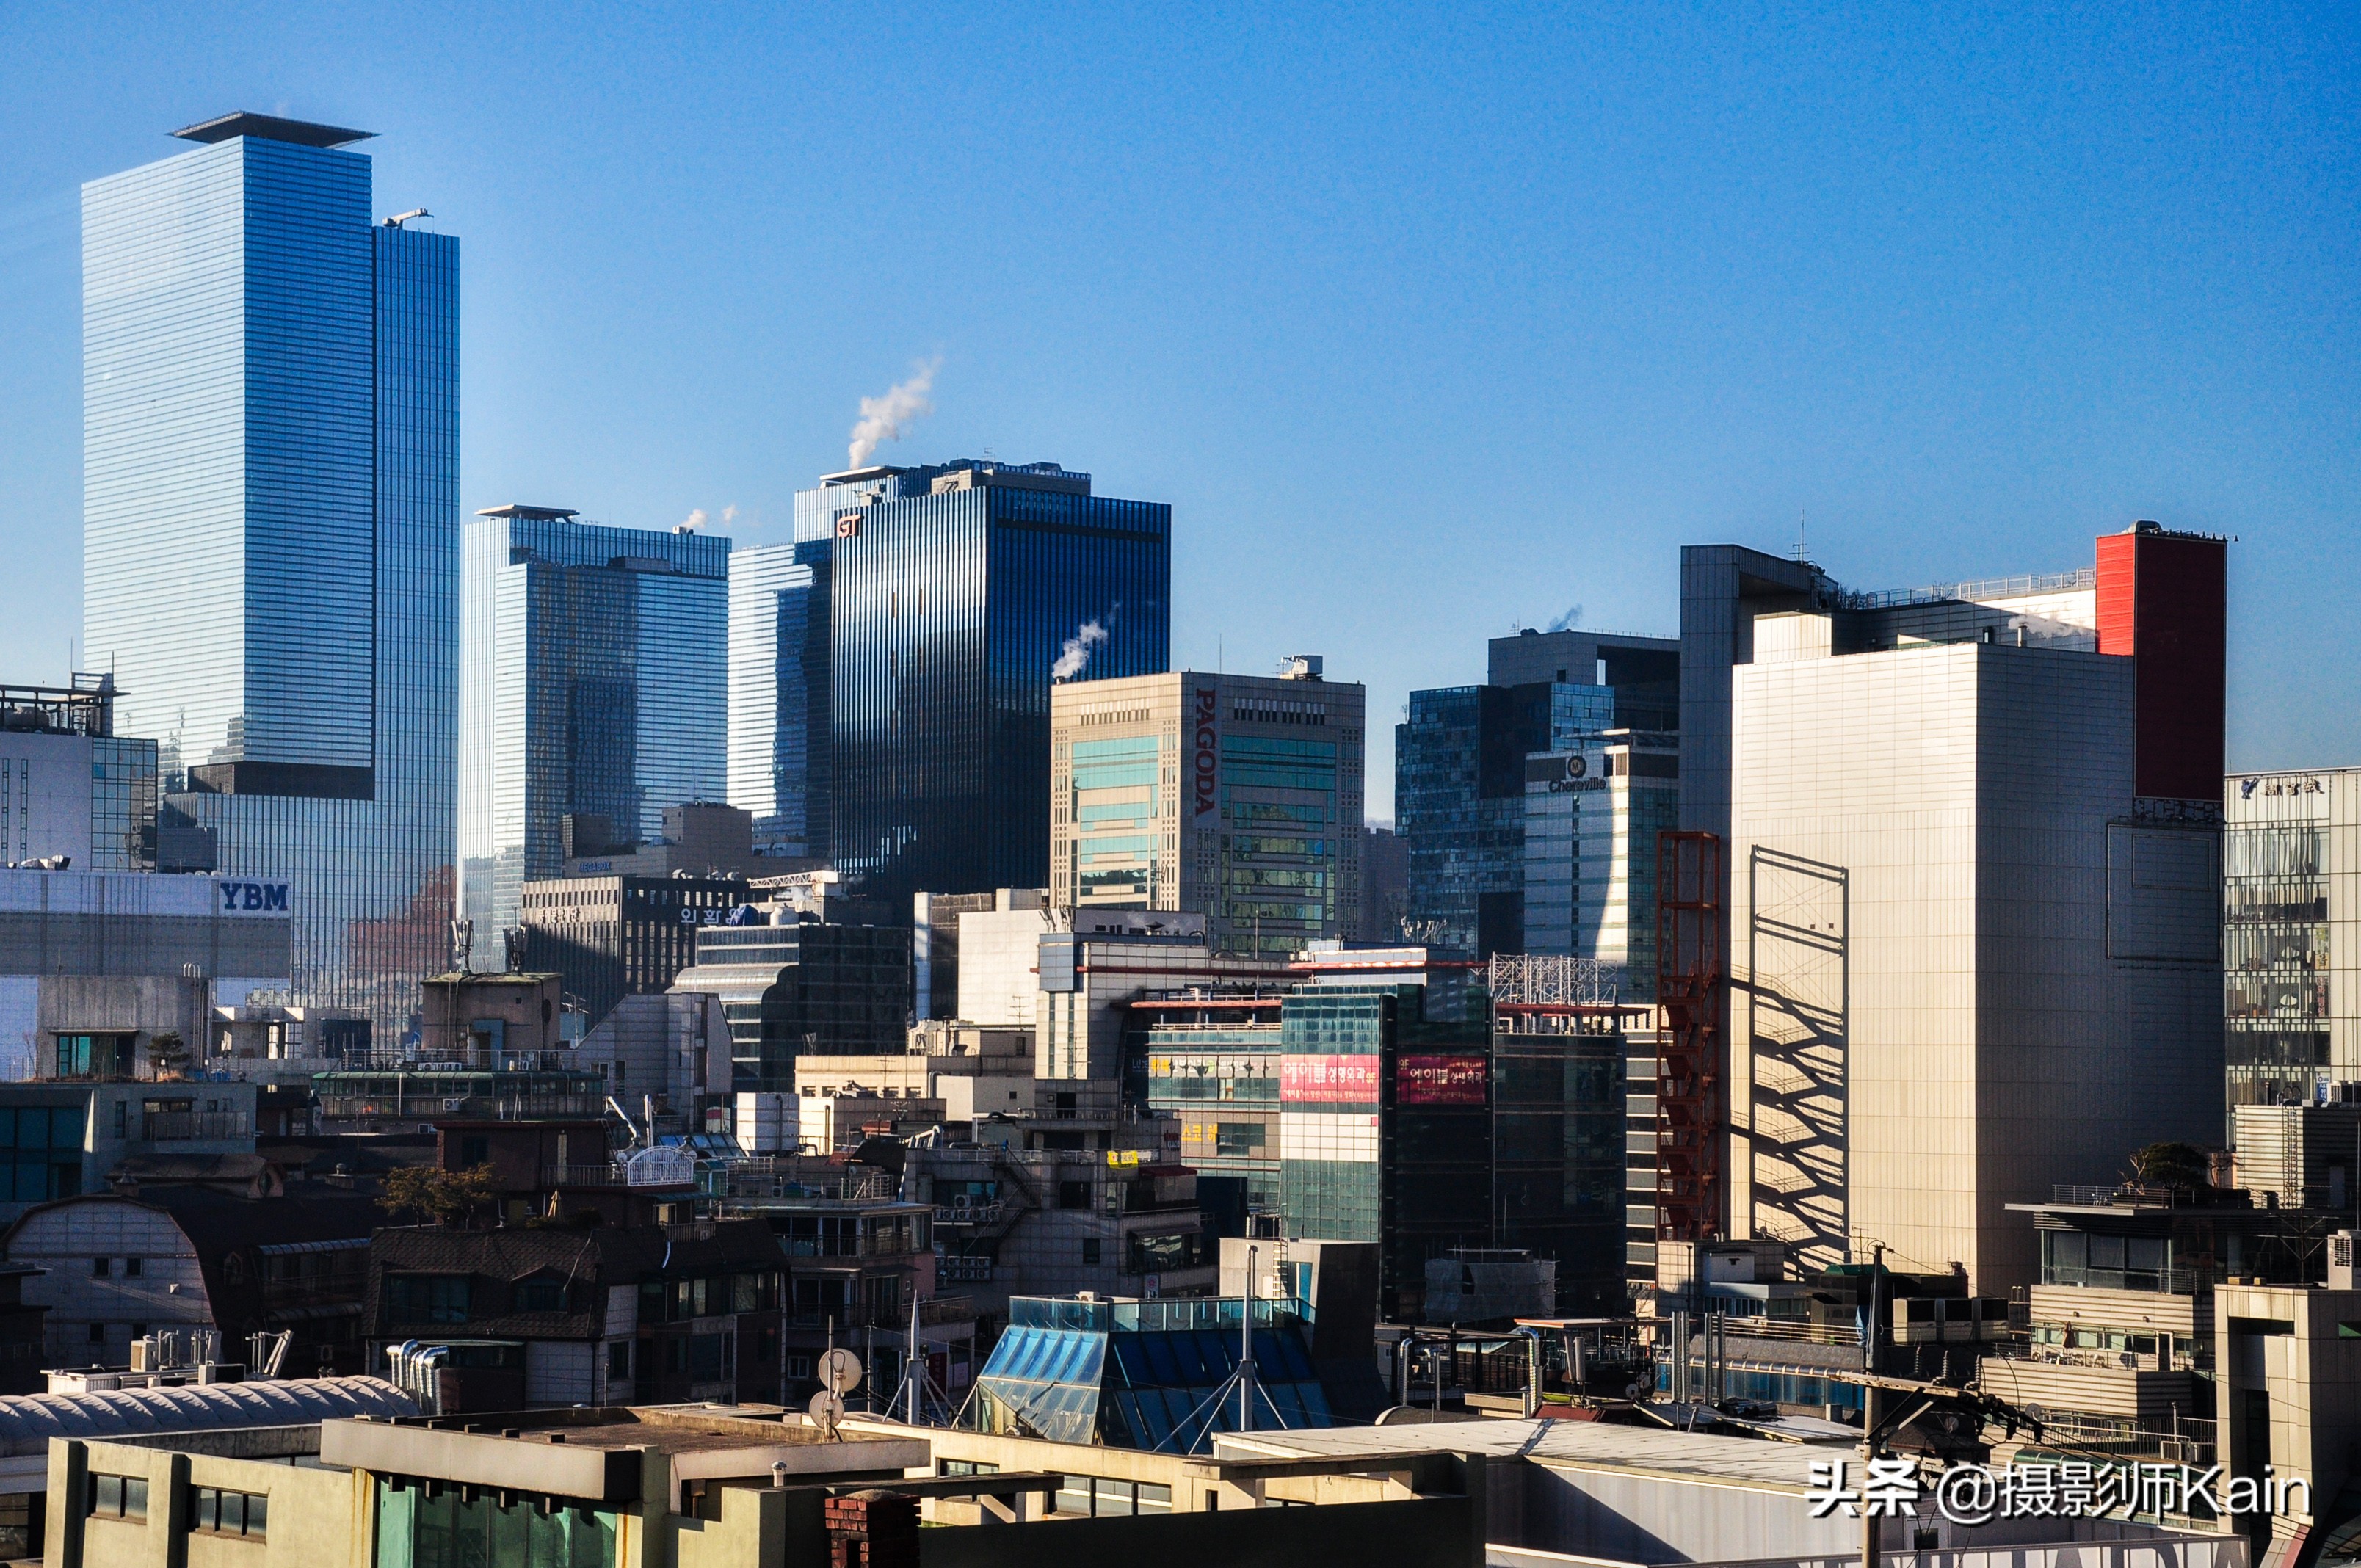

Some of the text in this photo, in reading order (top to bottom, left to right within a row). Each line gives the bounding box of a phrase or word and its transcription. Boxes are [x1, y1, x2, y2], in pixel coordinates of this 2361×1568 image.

[837, 515, 860, 537] GT
[1196, 688, 1216, 816] PAGODA
[1548, 777, 1606, 793] Chereville
[579, 862, 611, 872] MEGABOX
[220, 882, 288, 910] YBM
[1283, 1062, 1326, 1084] 에이블
[1328, 1067, 1365, 1084] 성형외과
[1410, 1068, 1448, 1084] 에이블
